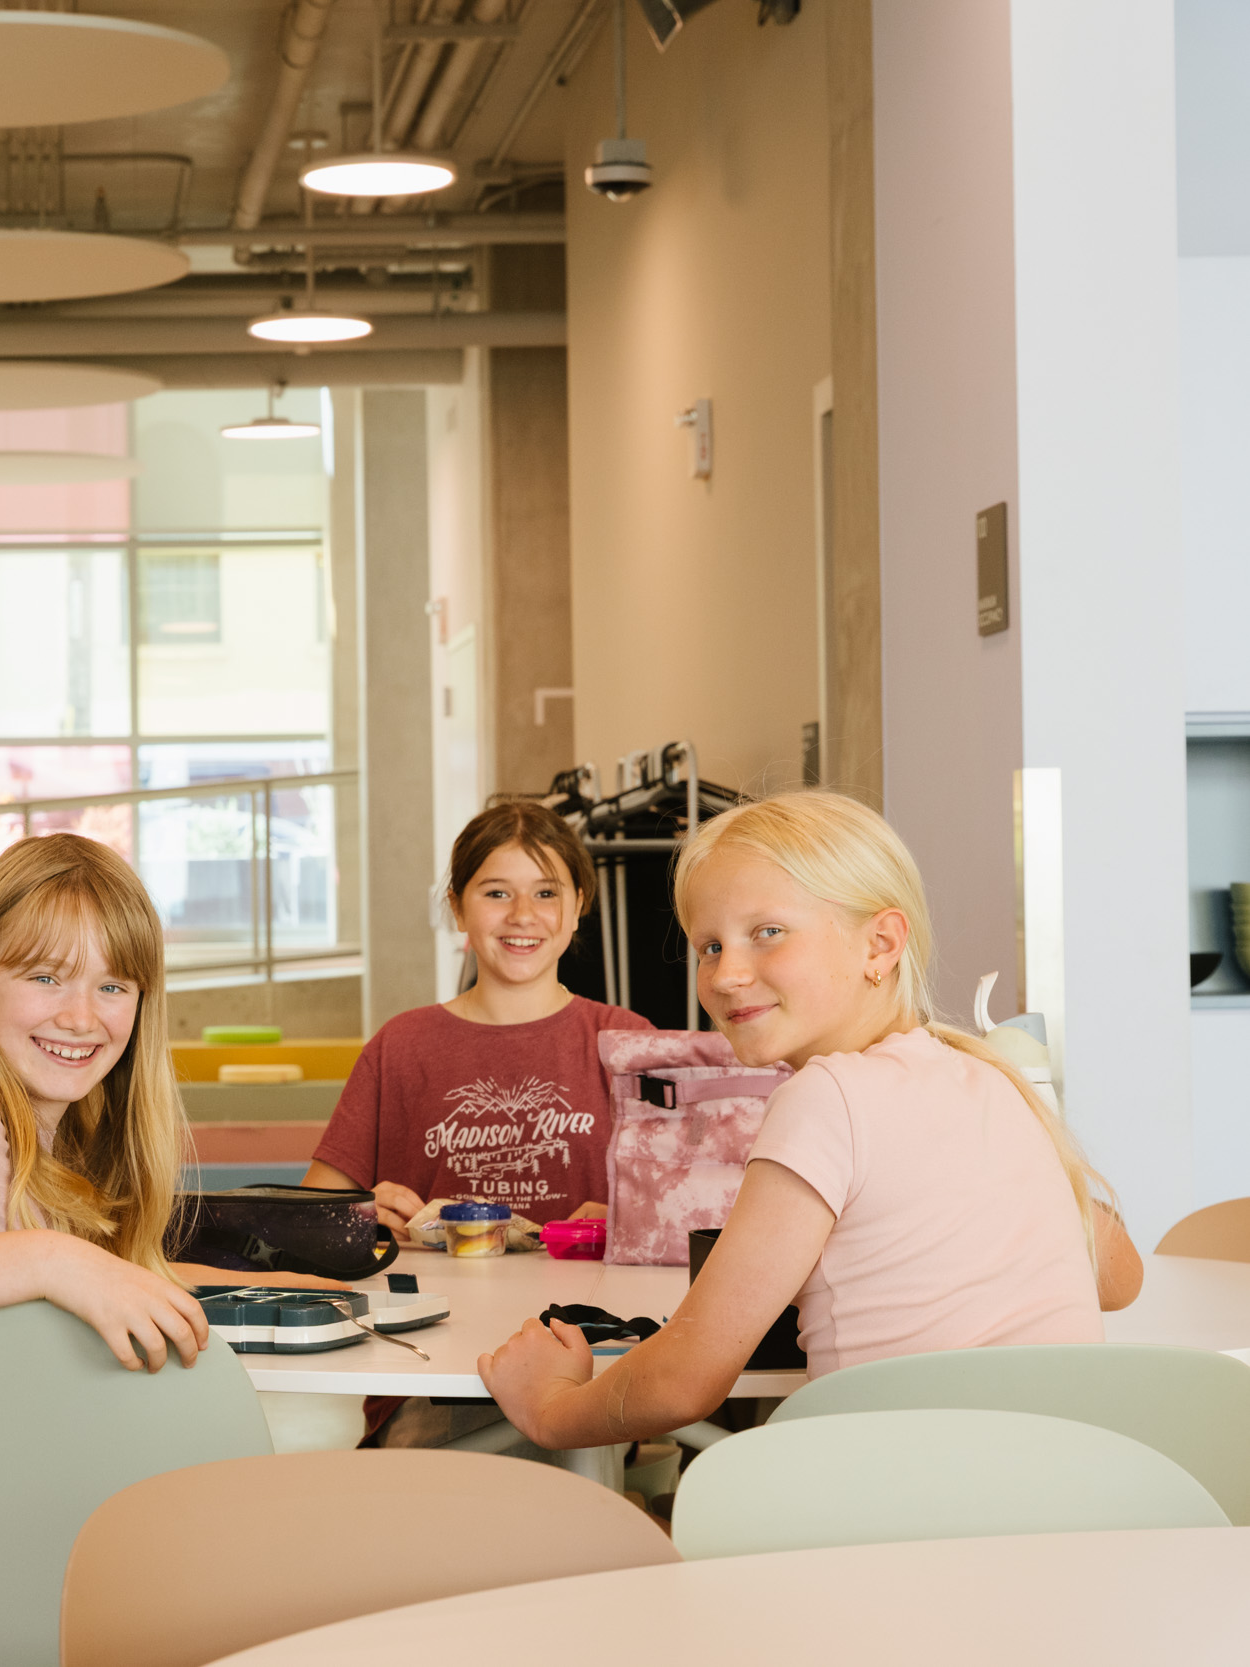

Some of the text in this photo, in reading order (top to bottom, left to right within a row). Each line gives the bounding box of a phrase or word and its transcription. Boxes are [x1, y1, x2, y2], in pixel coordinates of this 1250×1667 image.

[424, 1108, 595, 1158] MADISON RIVER
[469, 1179, 549, 1196] TUBING
[487, 1195, 513, 1203] WITH
[515, 1195, 532, 1203] THE
[534, 1193, 561, 1202] FLOW
